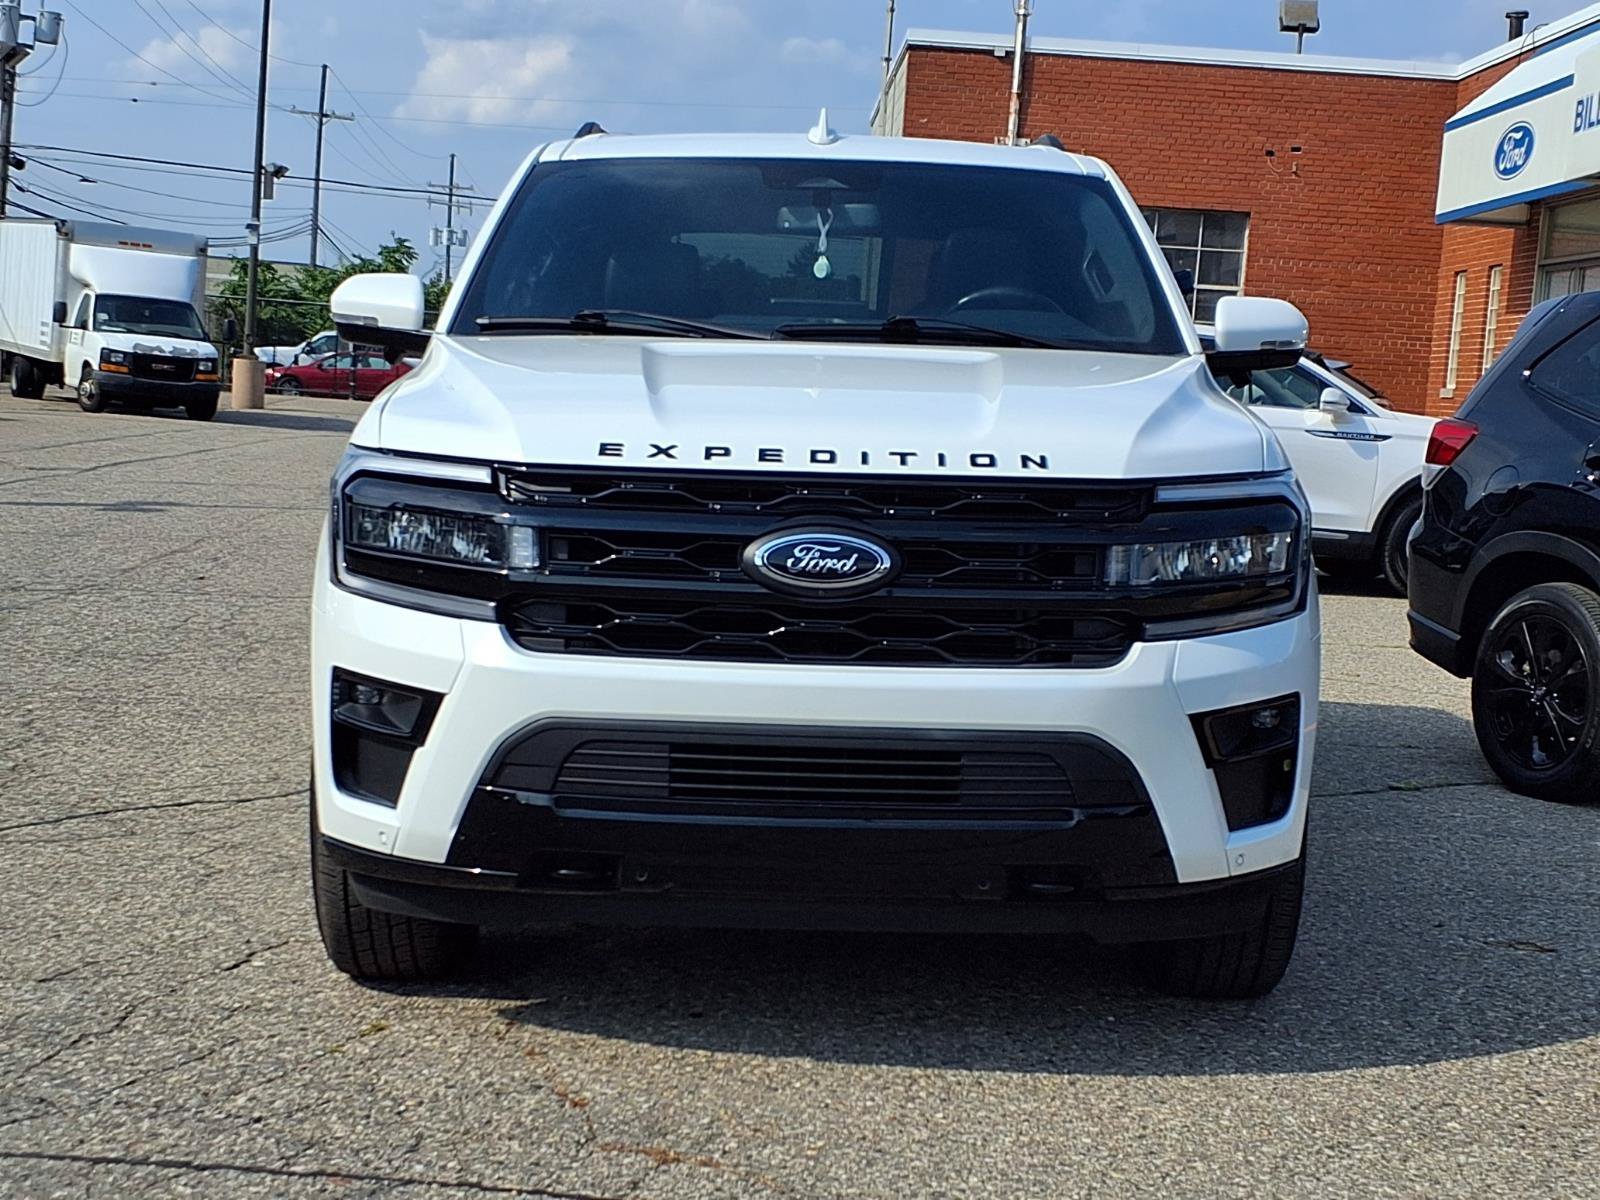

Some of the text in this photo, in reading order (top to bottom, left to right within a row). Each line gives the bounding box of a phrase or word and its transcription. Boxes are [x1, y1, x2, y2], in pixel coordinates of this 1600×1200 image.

[1500, 131, 1529, 171] Ford
[598, 442, 1048, 469] EXPEDITION
[786, 544, 857, 573] Ford
